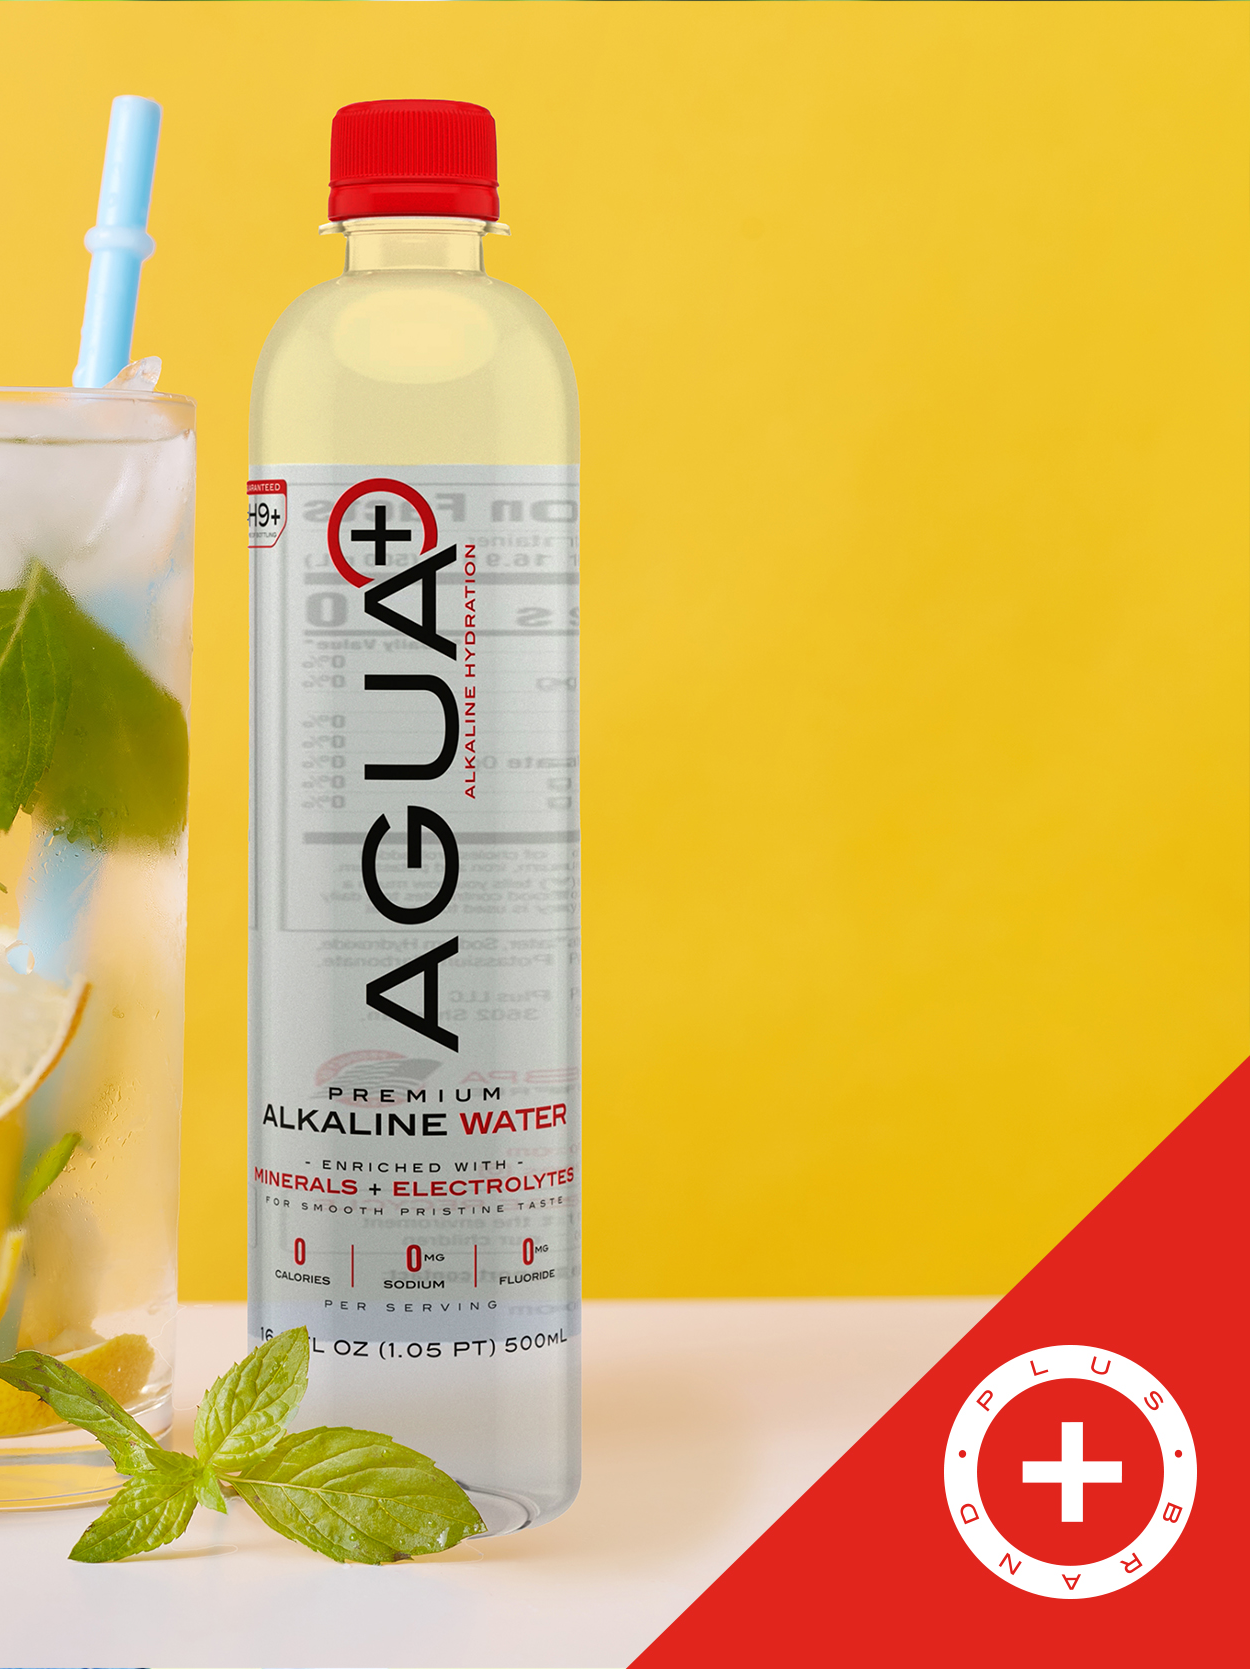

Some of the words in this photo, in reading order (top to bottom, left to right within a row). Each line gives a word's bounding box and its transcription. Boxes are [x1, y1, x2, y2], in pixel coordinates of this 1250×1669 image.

[465, 545, 475, 677] HYDRATION
[465, 687, 475, 799] ALKALINE
[329, 1087, 500, 1102] PREMIUM
[263, 1104, 447, 1136] ALKALINE
[460, 1103, 566, 1135] WATER
[323, 1160, 440, 1172] ENRICHED
[455, 1160, 505, 1172] WITH
[255, 1167, 357, 1195] MINERALS
[393, 1168, 574, 1196] ELECTROLYTES
[267, 1197, 289, 1205] FOR
[302, 1203, 382, 1215] SMOOTH
[401, 1205, 503, 1215] PRISTINE
[518, 1197, 562, 1209] TASTE
[295, 1238, 305, 1265] 0
[276, 1270, 330, 1285] CALORIES
[384, 1280, 444, 1289] SODIUM
[500, 1269, 554, 1285] FLUORIDE
[325, 1300, 366, 1310] PER
[387, 1301, 496, 1312] SERVING
[334, 1340, 368, 1356] OZ
[380, 1342, 441, 1359] (1.05
[454, 1339, 495, 1357] PT)
